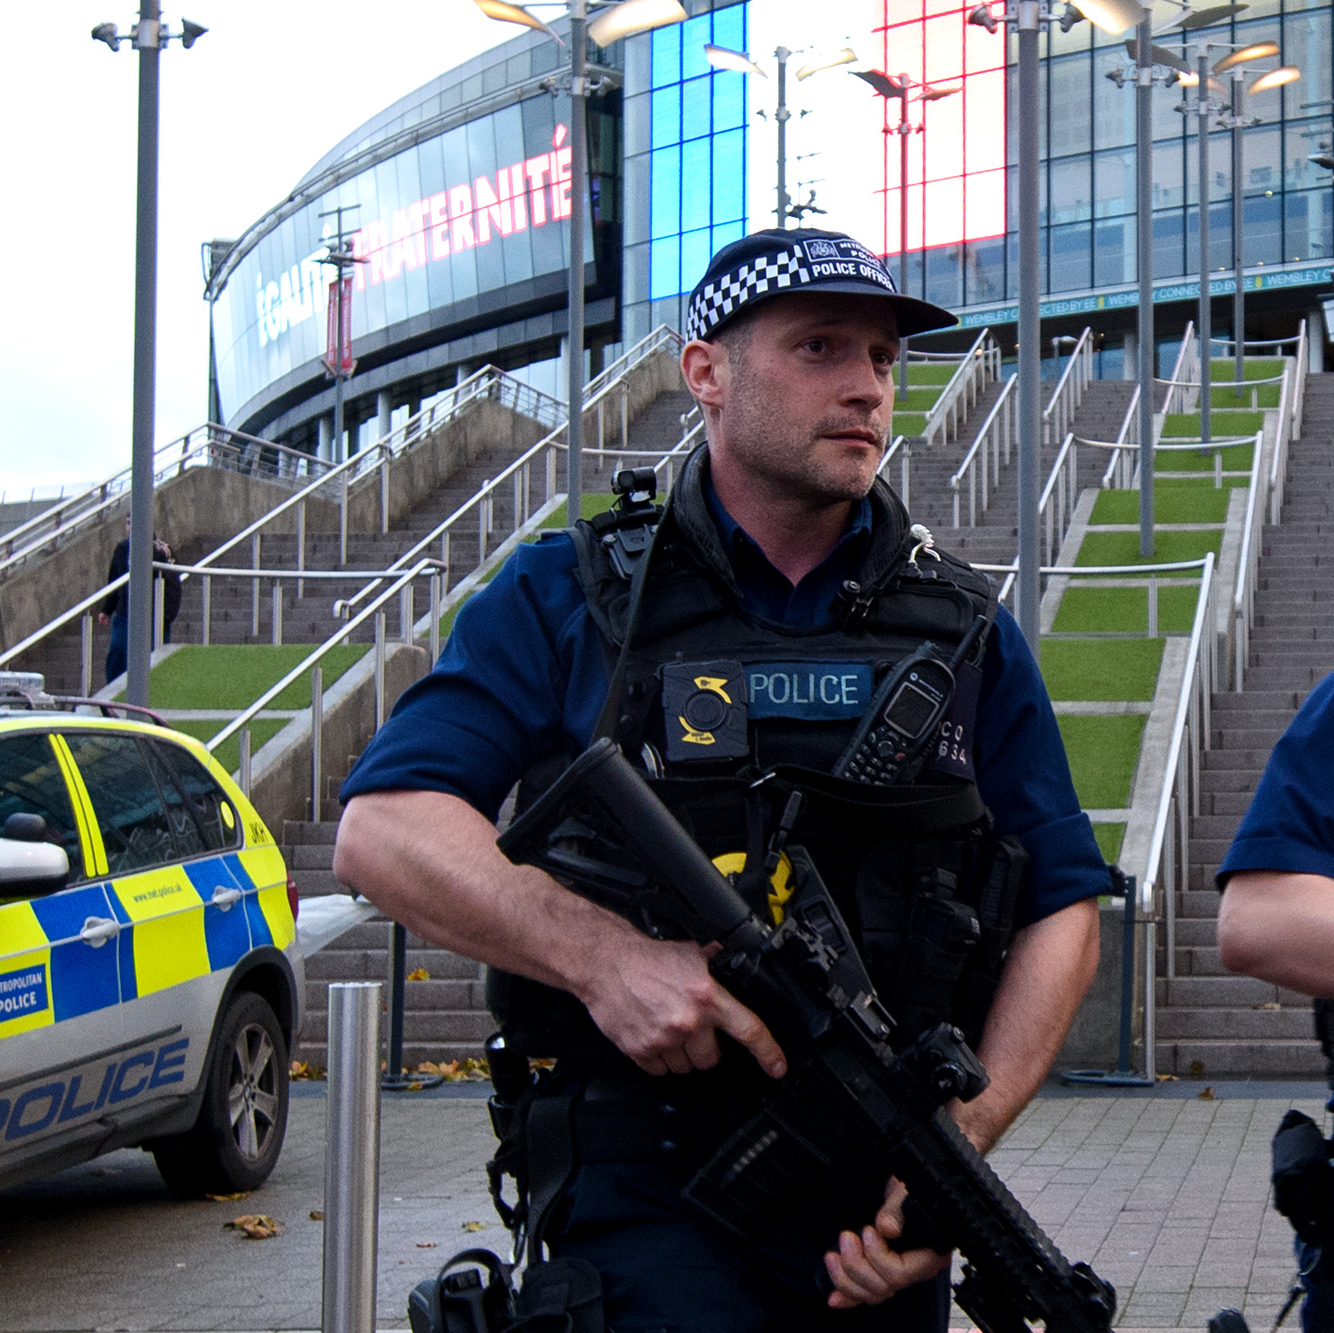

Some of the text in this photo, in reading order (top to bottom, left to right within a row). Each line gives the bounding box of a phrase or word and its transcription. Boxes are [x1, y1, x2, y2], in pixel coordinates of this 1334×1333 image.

[353, 123, 572, 292] FRATERNITÉ
[812, 261, 857, 277] POLICE
[1267, 270, 1320, 287] WEMBLEY
[1159, 281, 1223, 298] CONNECED
[966, 298, 1096, 325] WEMBLEY CECTED BY EE
[750, 673, 859, 704] POLICE
[938, 740, 967, 765] 634
